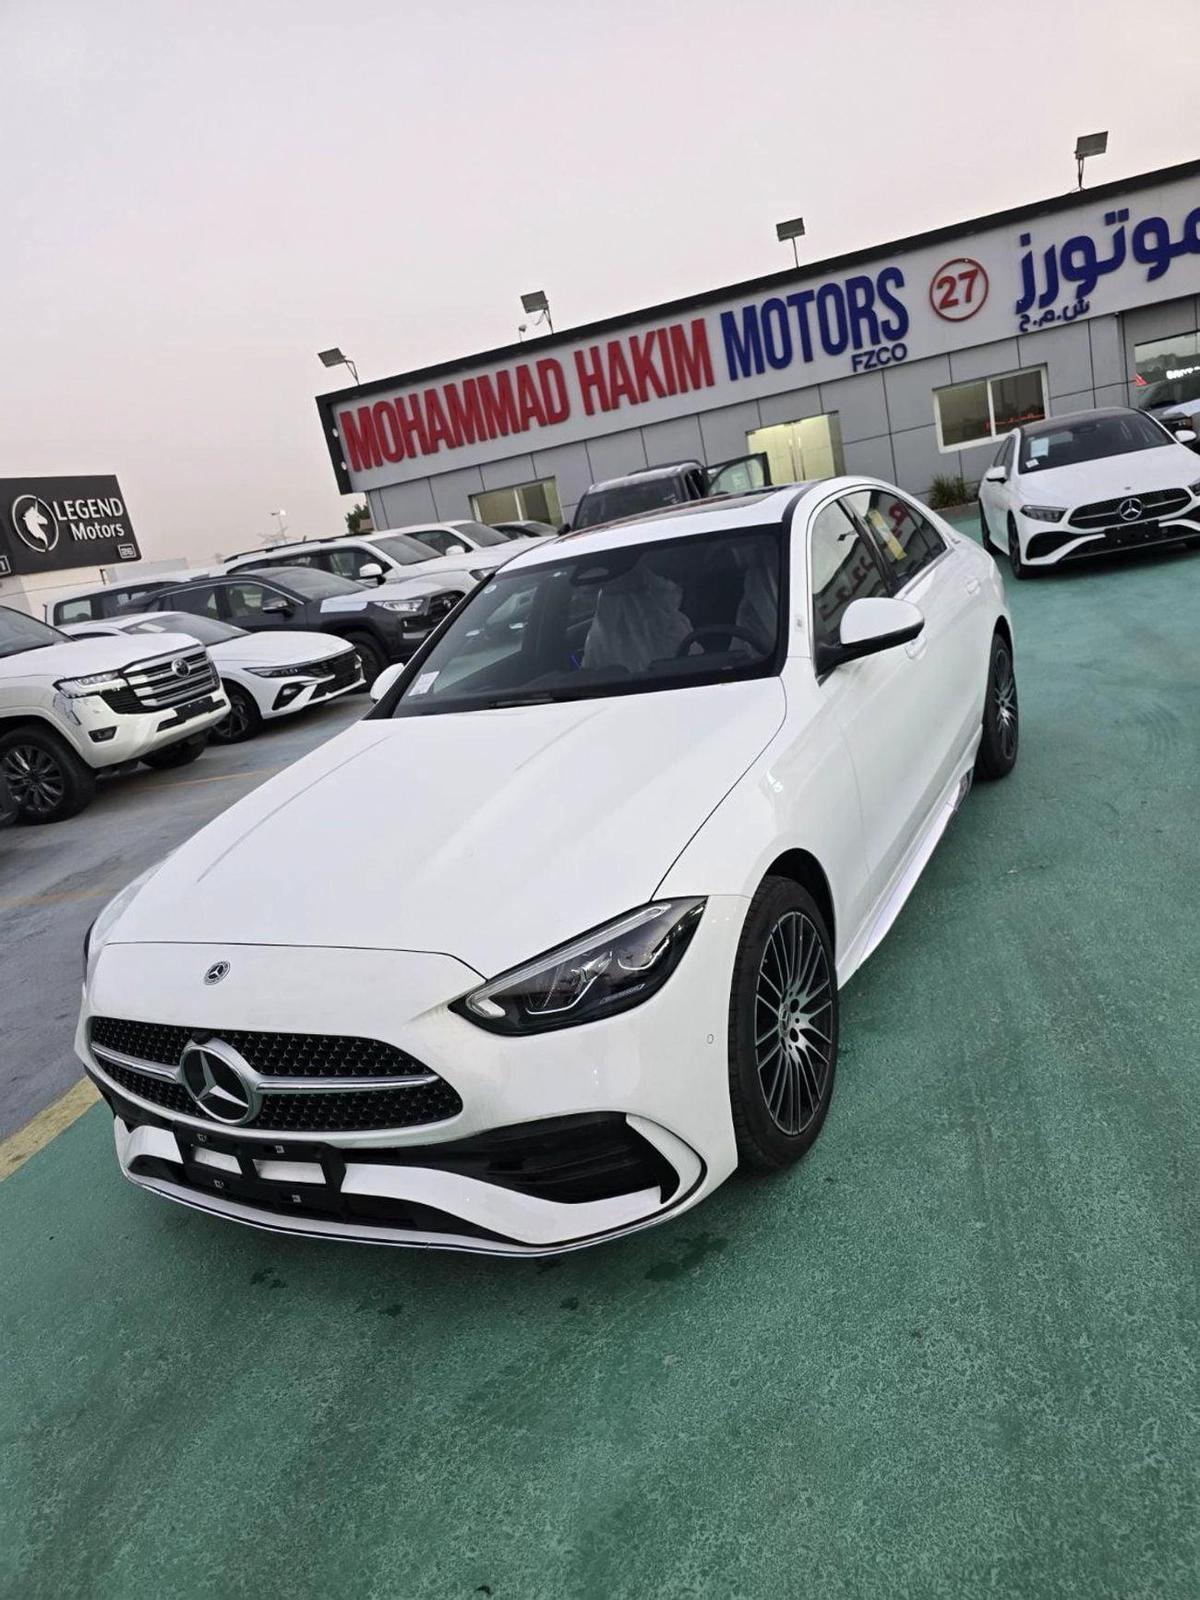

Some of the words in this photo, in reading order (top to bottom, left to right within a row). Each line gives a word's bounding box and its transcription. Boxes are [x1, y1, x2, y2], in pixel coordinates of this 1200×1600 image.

[935, 269, 979, 310] 27
[340, 358, 570, 472] MOHAMMAD
[574, 318, 715, 417] HAKIM
[721, 267, 909, 381] MOTORS
[851, 343, 908, 373] FZCO
[53, 498, 124, 521] LEGEND
[70, 522, 124, 541] Motors
